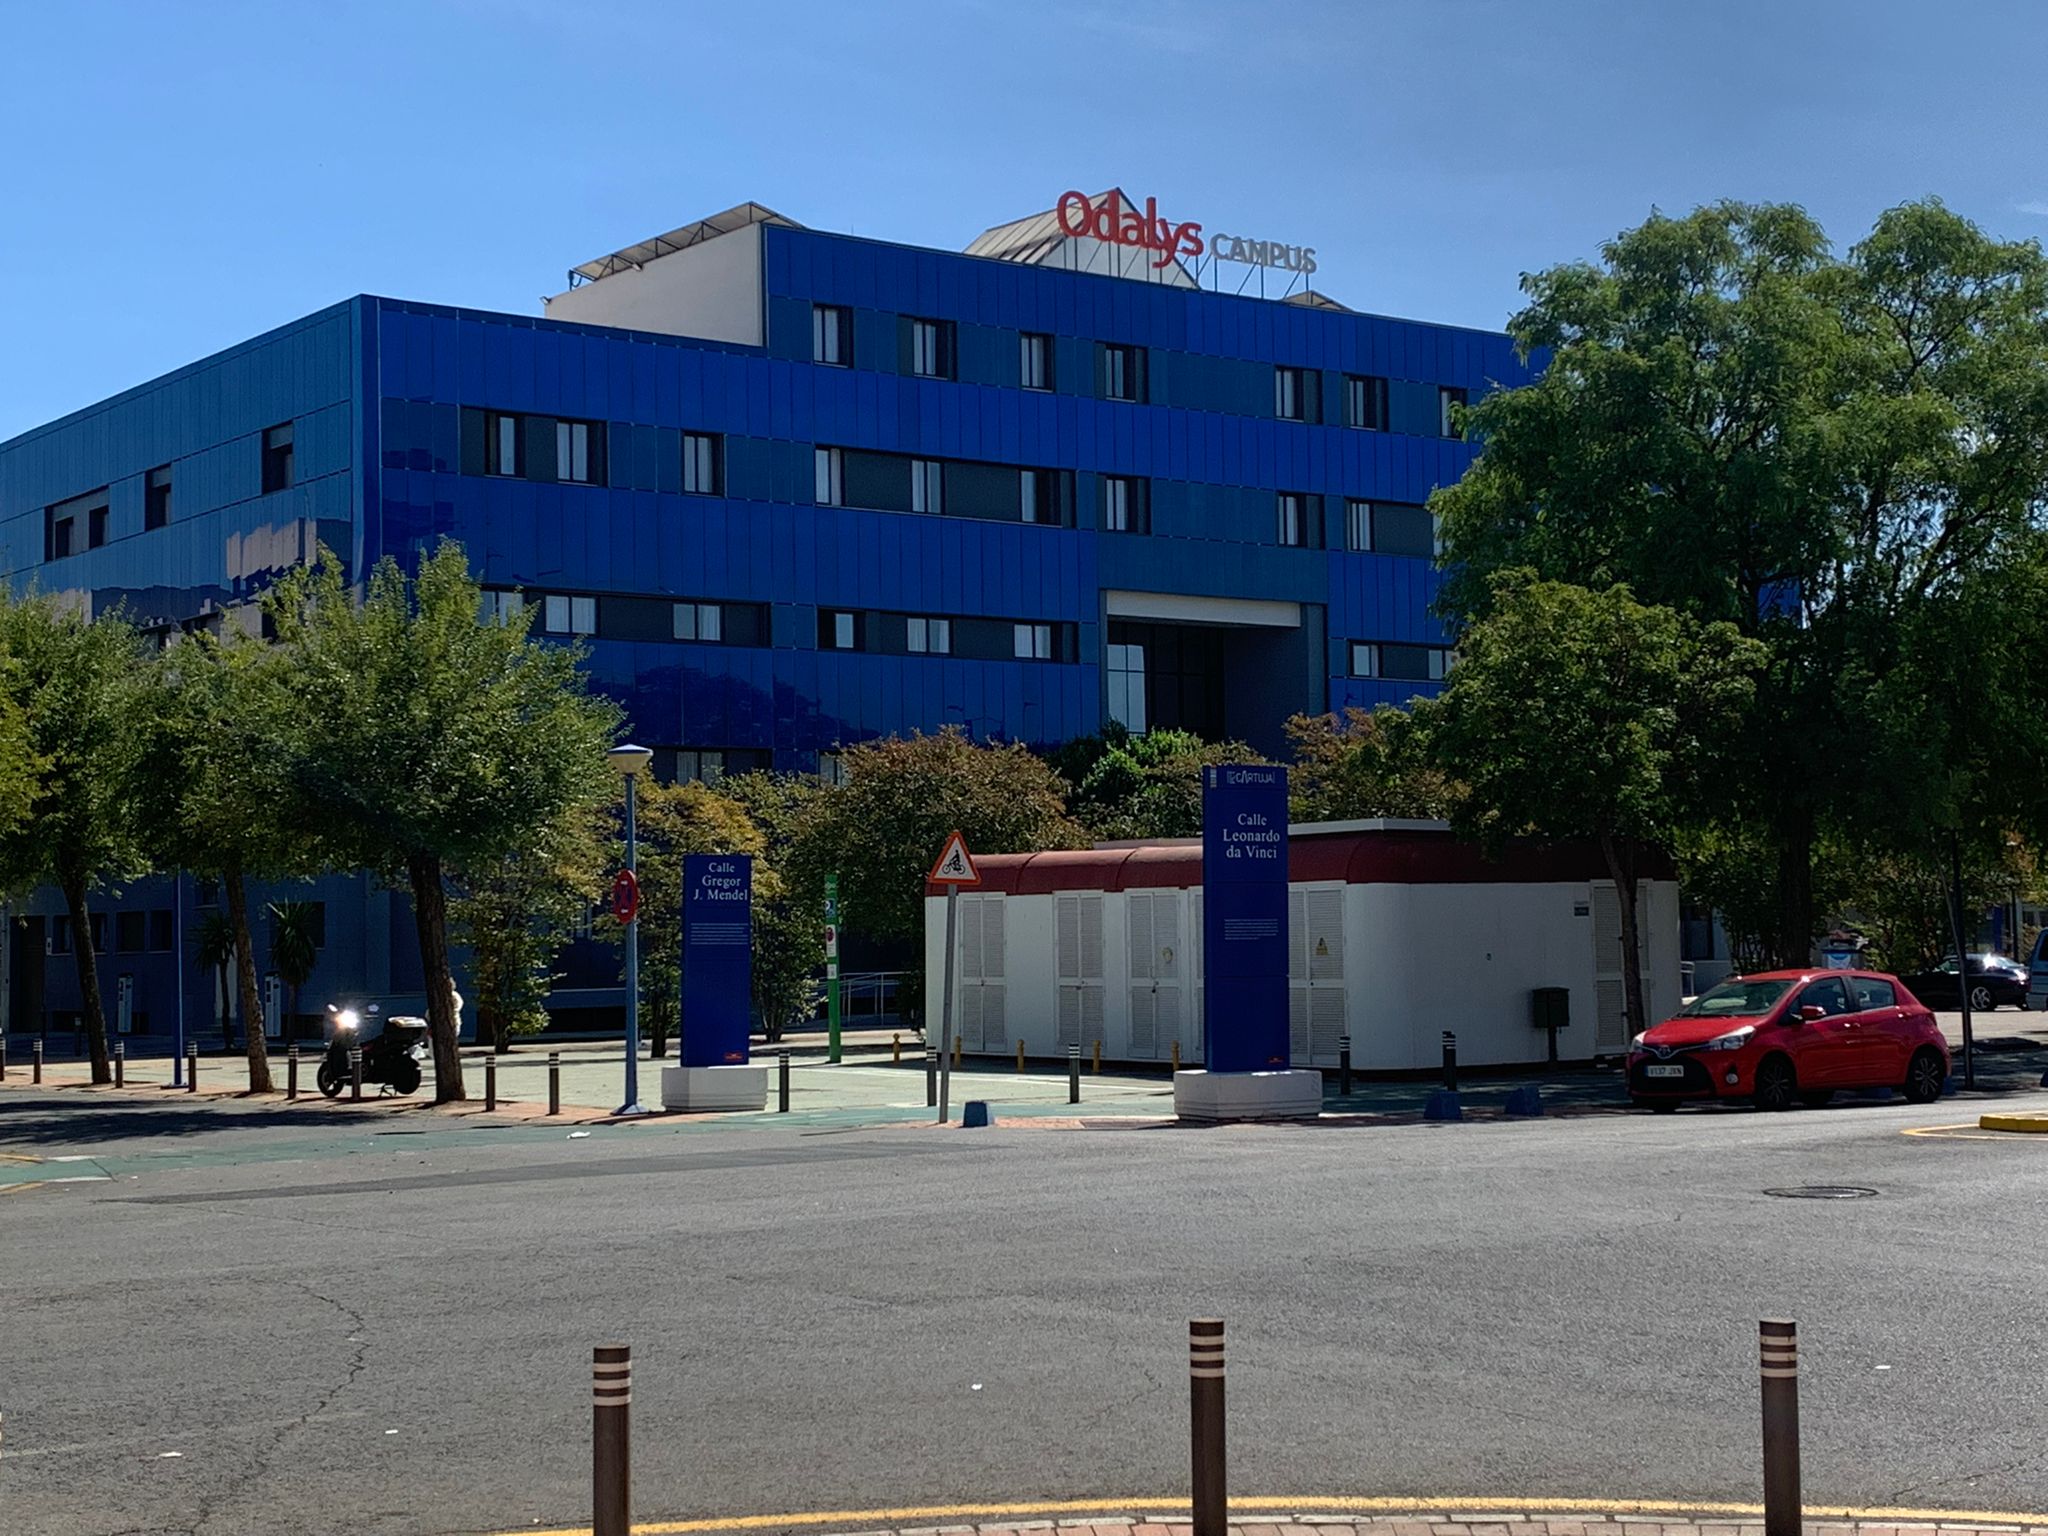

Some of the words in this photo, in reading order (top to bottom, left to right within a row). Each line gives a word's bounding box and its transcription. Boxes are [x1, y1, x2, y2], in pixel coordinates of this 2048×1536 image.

[1057, 190, 1204, 268] Odalys
[1210, 233, 1317, 274] CAMPUS
[1237, 813, 1267, 826] Calle
[1223, 828, 1280, 842] Leonardo
[1226, 845, 1241, 858] da
[1246, 845, 1277, 858] Vinci
[708, 862, 735, 873] Calle
[702, 875, 741, 889] Gregor
[693, 889, 703, 900] J.
[707, 889, 748, 900] Mendel
